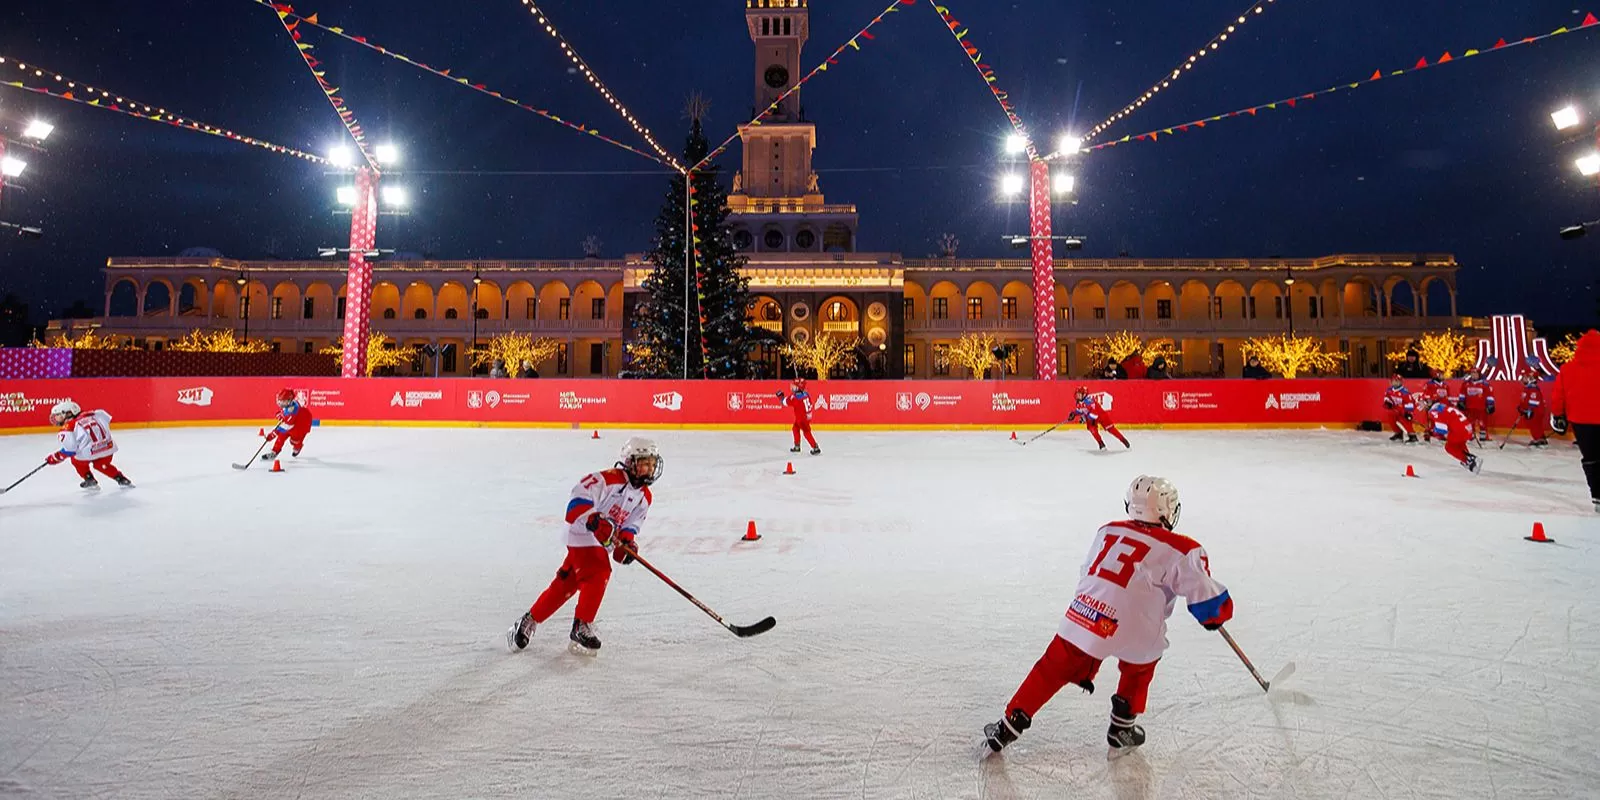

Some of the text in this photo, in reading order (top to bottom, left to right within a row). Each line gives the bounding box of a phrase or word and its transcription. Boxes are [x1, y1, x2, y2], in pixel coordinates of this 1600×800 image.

[180, 388, 204, 401] ХИТ
[655, 393, 674, 405] ХИТ
[0, 397, 72, 406] СПОРТИВНЫЙ
[580, 473, 598, 489] 17
[1087, 533, 1151, 589] 13
